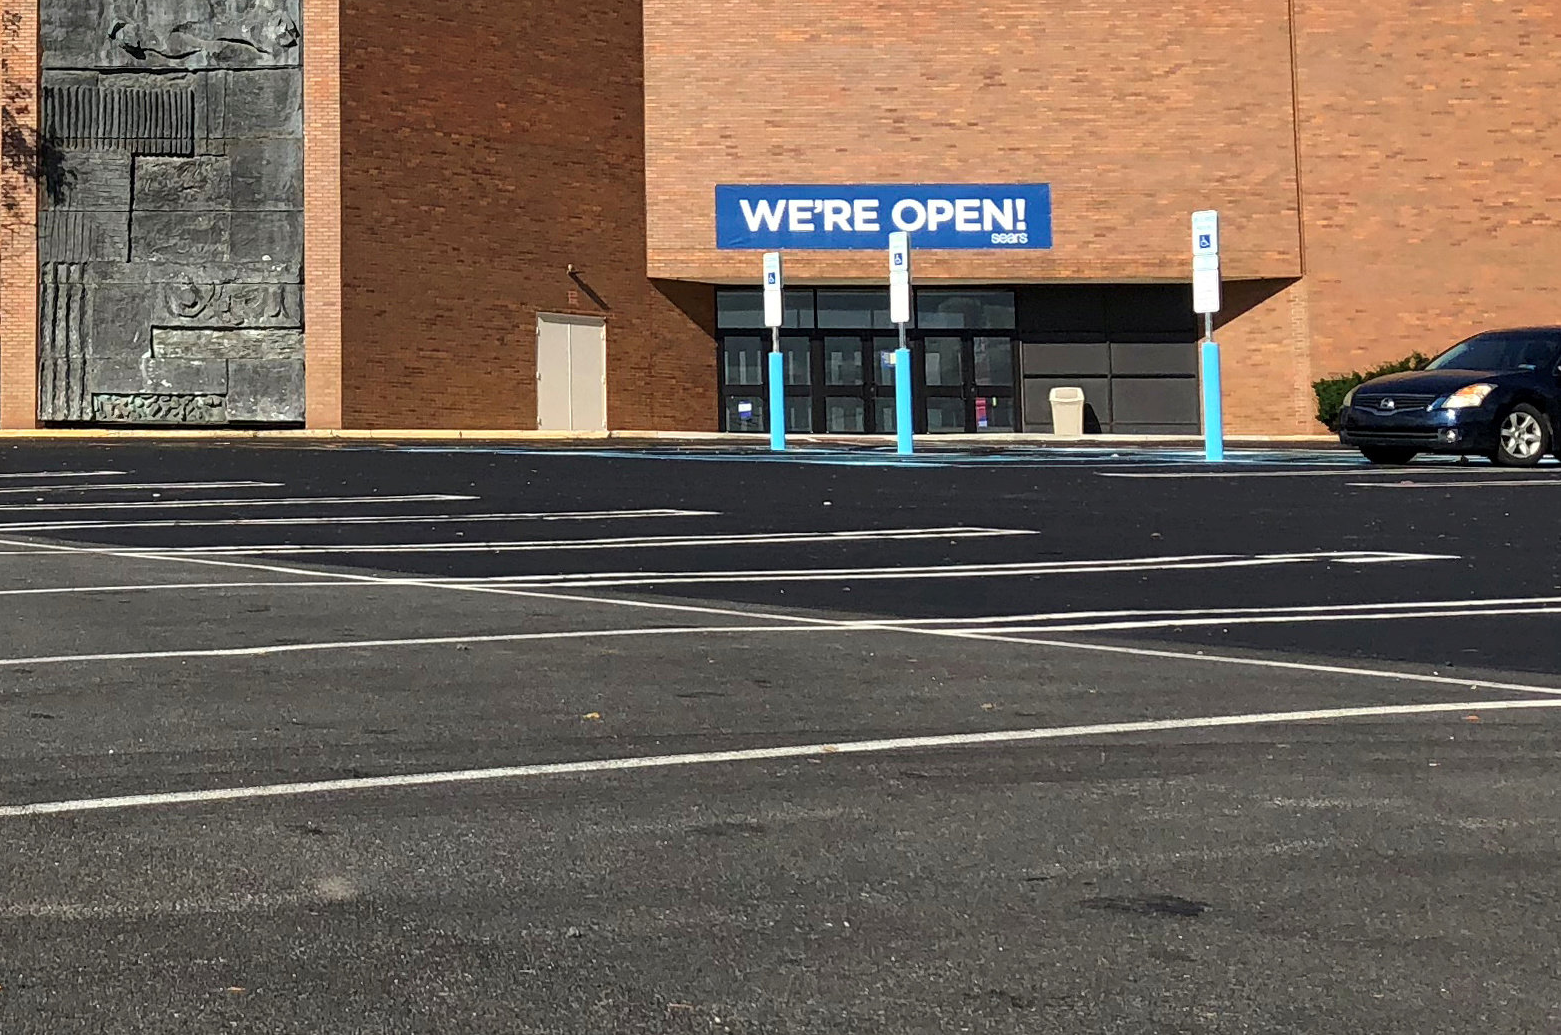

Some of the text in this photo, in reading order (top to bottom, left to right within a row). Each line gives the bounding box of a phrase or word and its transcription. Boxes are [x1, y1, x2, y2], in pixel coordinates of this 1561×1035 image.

[739, 198, 1027, 232] WE'RE OPEN!
[990, 231, 1029, 244] sears
